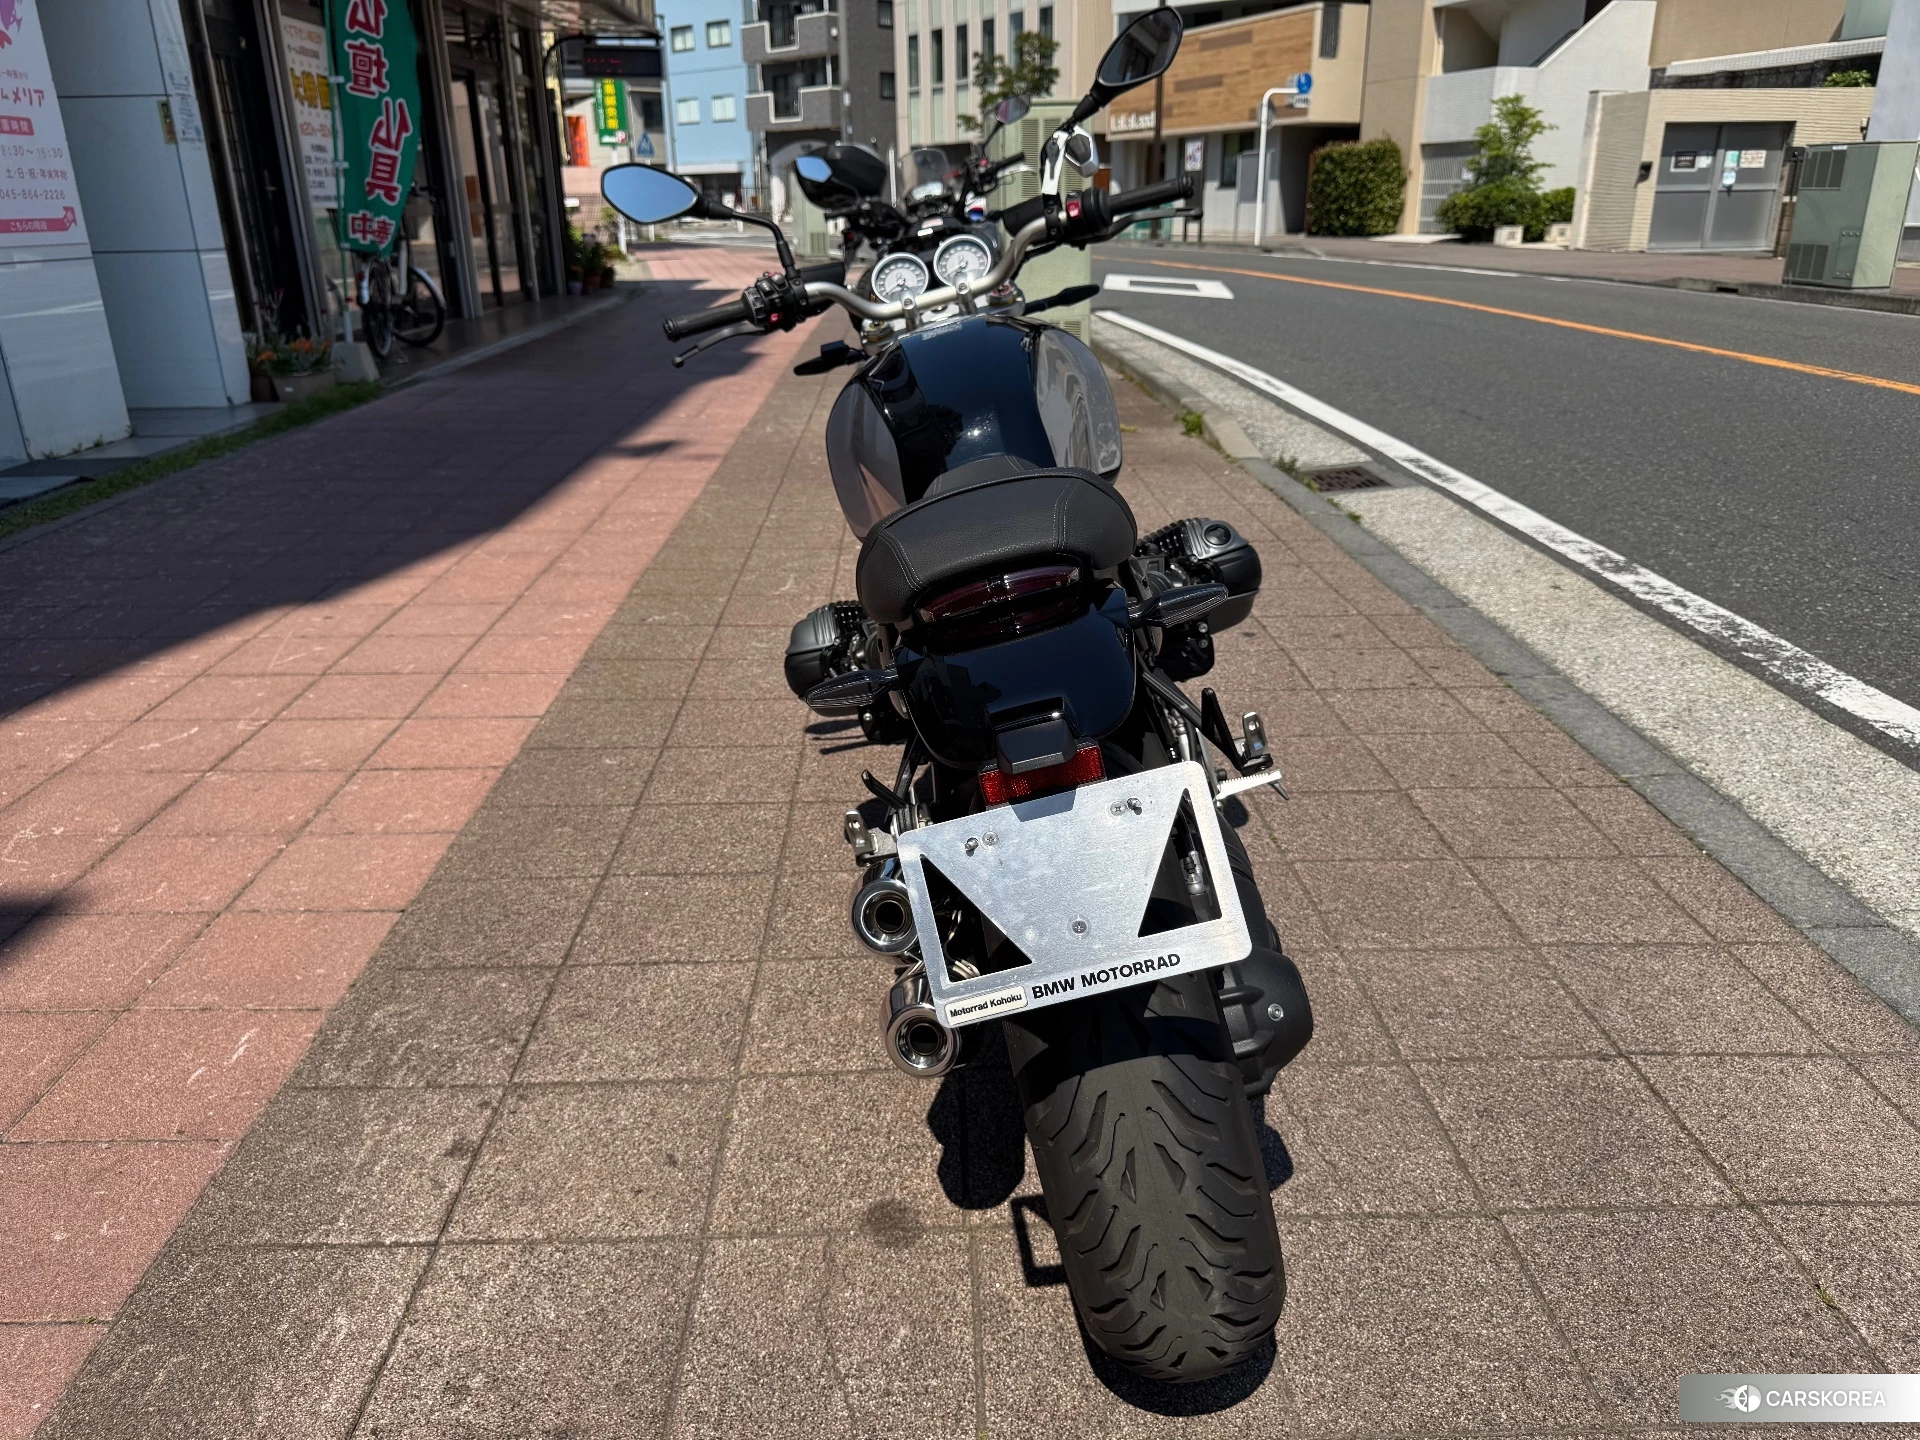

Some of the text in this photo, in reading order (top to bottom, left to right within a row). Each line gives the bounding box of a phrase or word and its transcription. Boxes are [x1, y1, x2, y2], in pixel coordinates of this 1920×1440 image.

[1031, 953, 1181, 999] BMW MOTORRAD
[949, 992, 1023, 1018] Motorrad Kohoku
